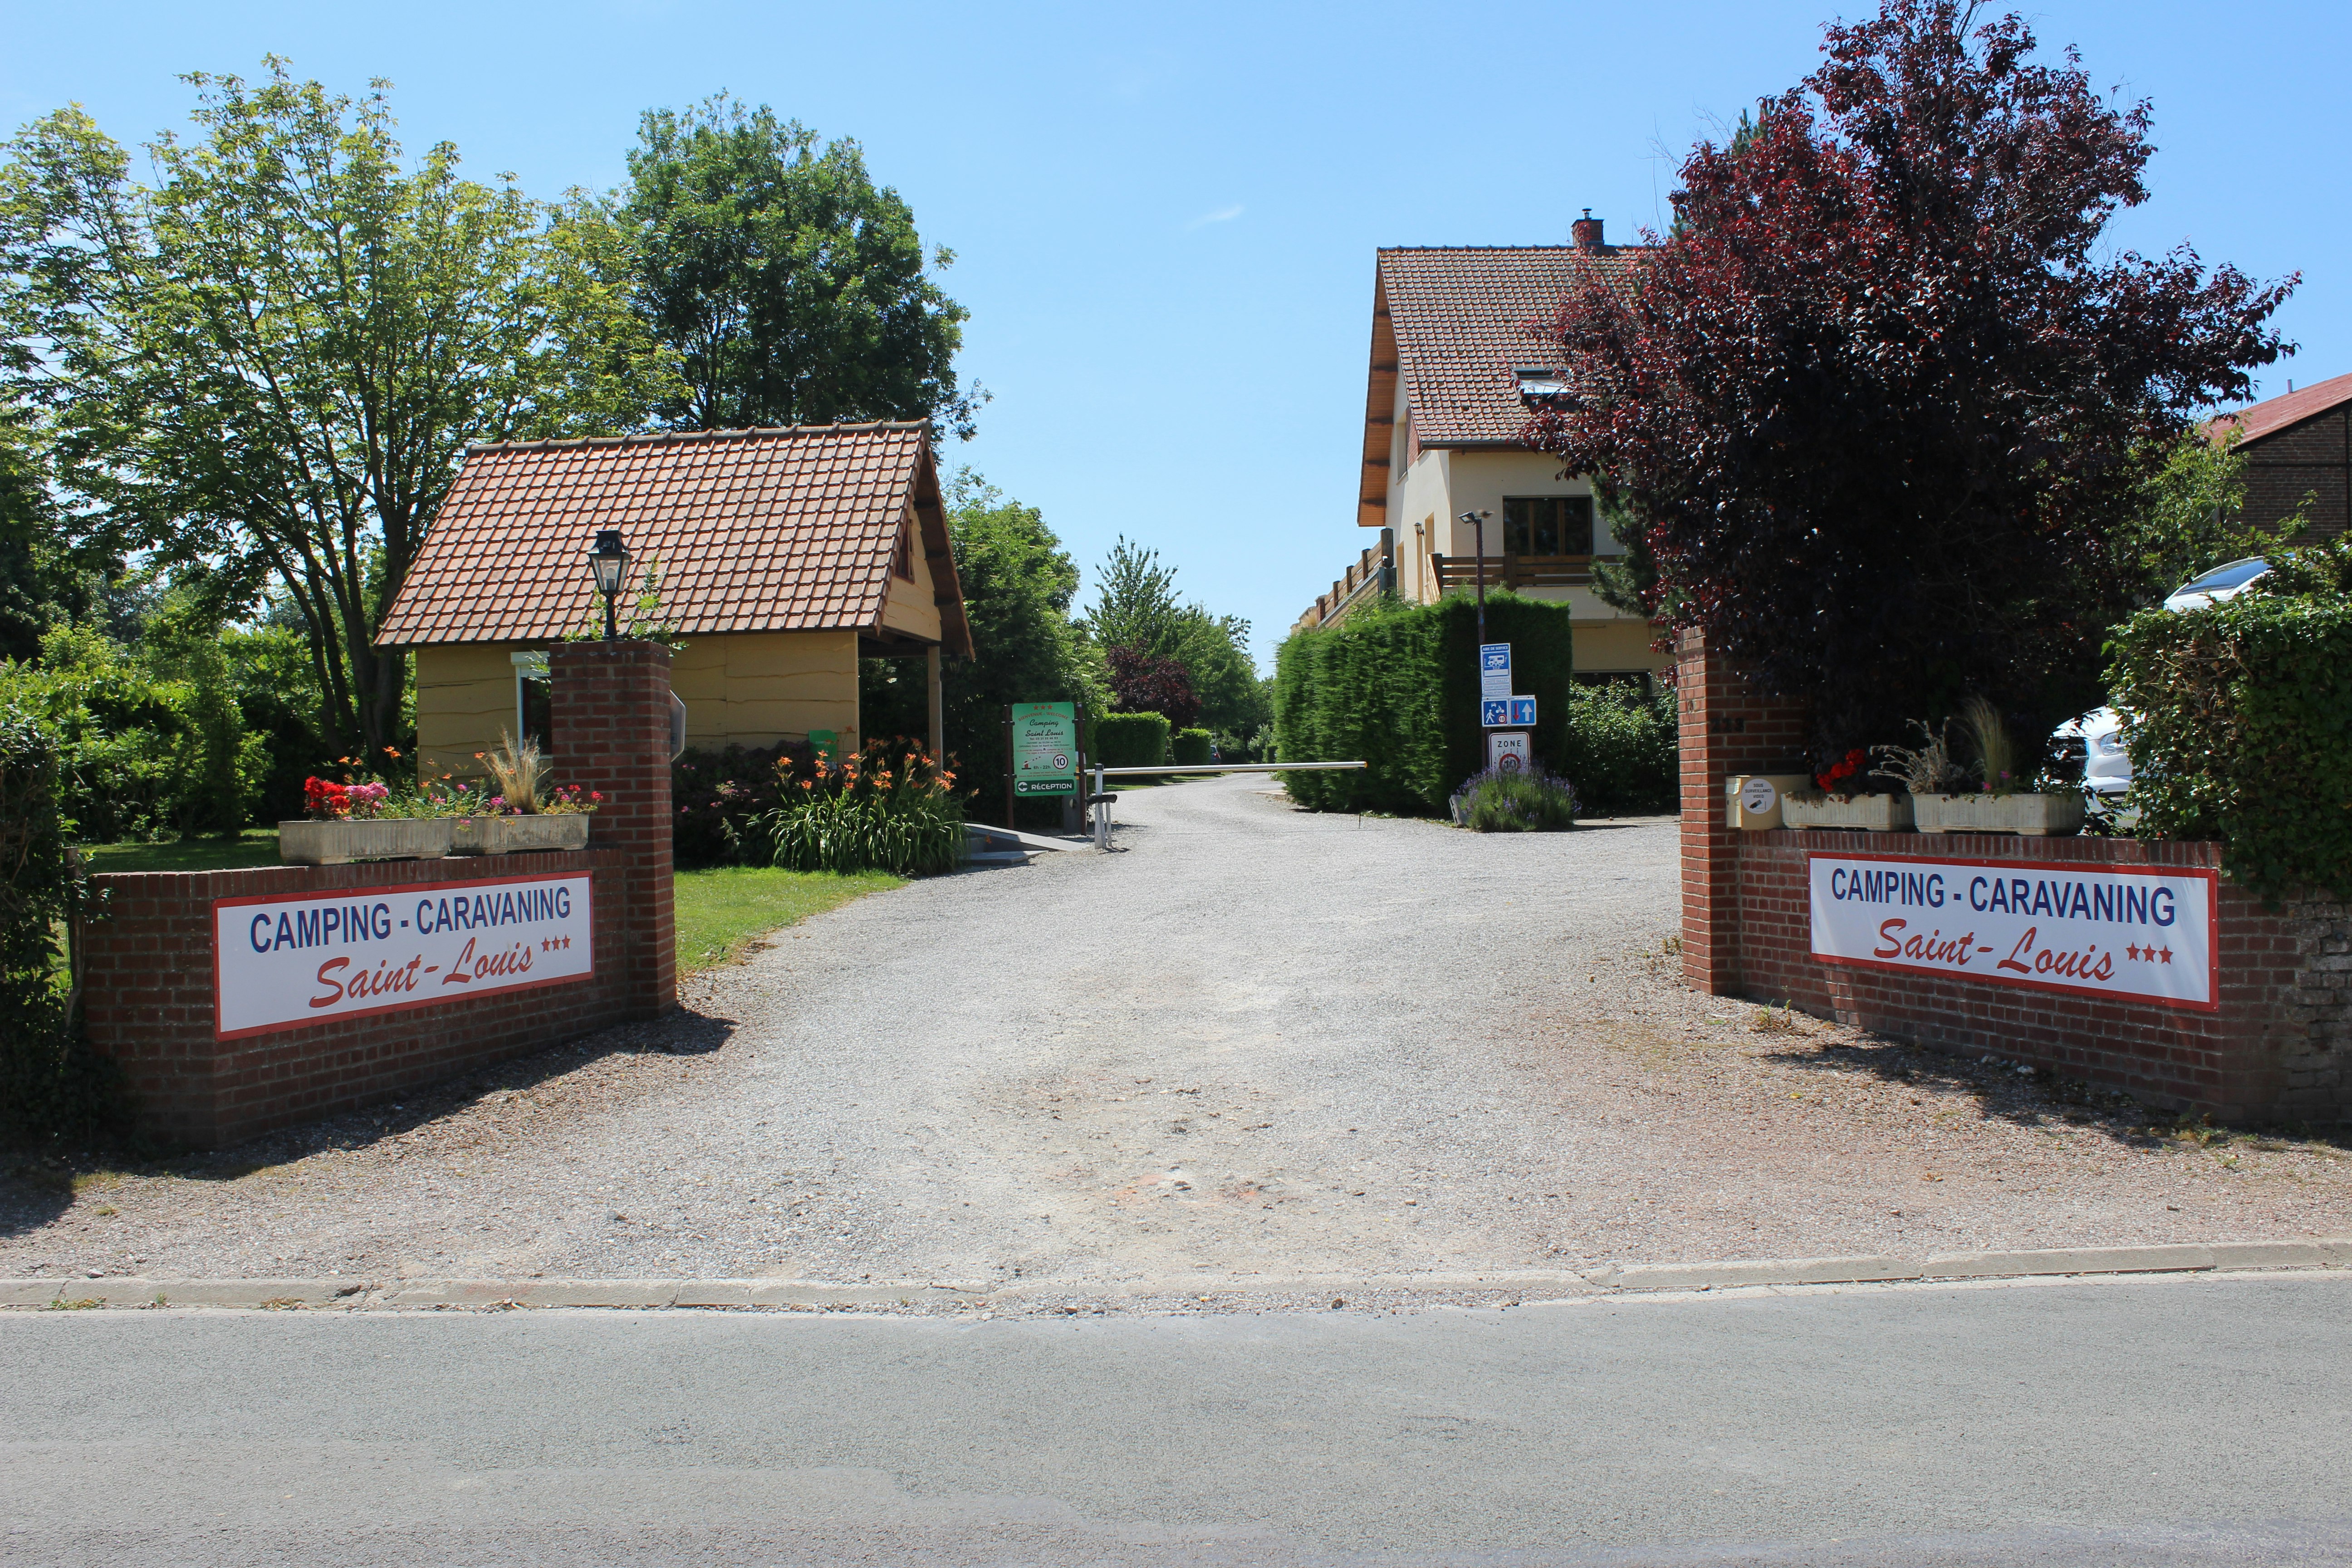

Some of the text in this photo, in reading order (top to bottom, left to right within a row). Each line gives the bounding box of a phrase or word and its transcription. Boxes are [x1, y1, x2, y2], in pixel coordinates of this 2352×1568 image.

[1018, 712, 1042, 721] BIENVENUE
[1046, 711, 1068, 720] WELCOME
[1029, 719, 1059, 728] Camping
[1056, 758, 1065, 766] 10
[1832, 867, 1944, 908] CAMPING
[1970, 876, 2175, 926] CARAVANING
[250, 913, 391, 953] CAMPING
[416, 886, 571, 935] CARAVANING
